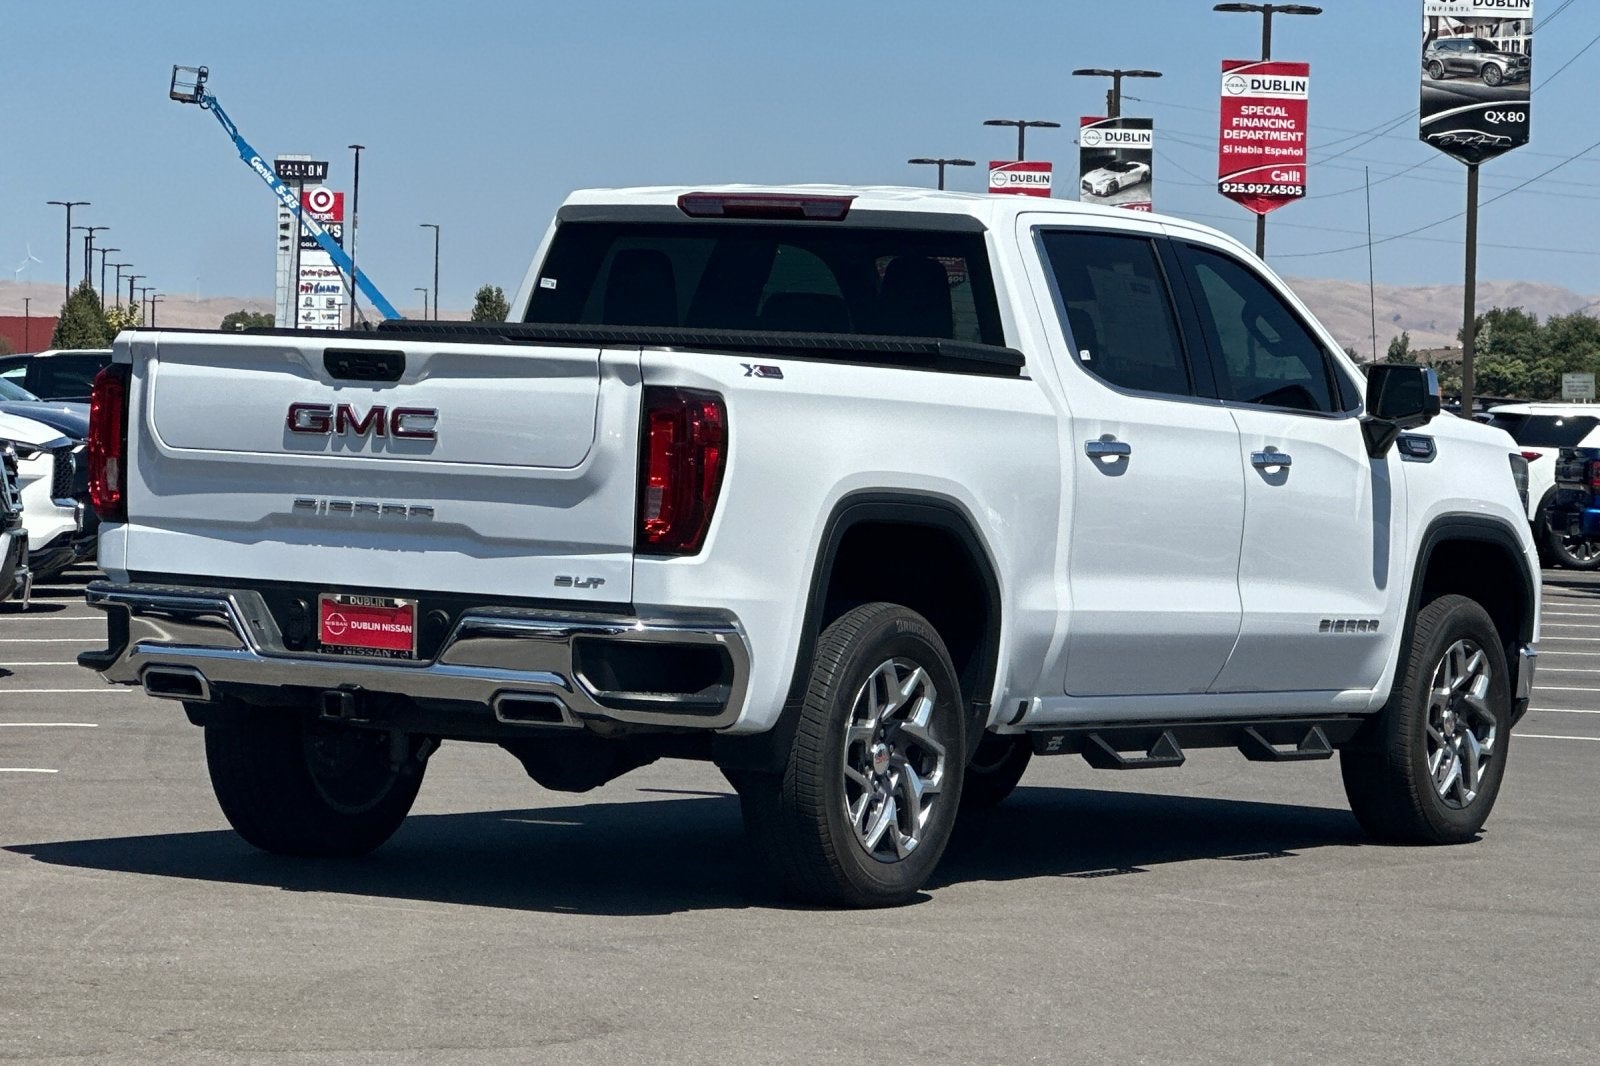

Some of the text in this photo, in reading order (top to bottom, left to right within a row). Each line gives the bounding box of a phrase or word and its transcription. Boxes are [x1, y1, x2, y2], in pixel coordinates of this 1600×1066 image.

[1473, 0, 1530, 8] DUBLIN
[1251, 79, 1306, 92] DUBLIN
[1240, 105, 1288, 117] SPECIAL
[1484, 110, 1526, 124] QX80
[1232, 117, 1296, 129] FINANCING
[1104, 131, 1151, 143] DUBLIN
[1223, 130, 1304, 142] DEPARTMENT
[1234, 145, 1263, 154] Habla
[1264, 146, 1304, 157] Español
[1010, 173, 1050, 184] DUBLIN
[1271, 170, 1300, 182] Call!
[250, 156, 300, 210] Genie S-85
[1222, 183, 1303, 195] 925.997.4505
[301, 223, 342, 238] DK'S
[286, 401, 439, 441] GMC
[554, 575, 606, 589] SLT
[349, 596, 385, 607] DUBLIN
[350, 621, 381, 631] DUBLIN
[381, 624, 412, 634] NISSAN
[1319, 618, 1380, 633] SIERRA
[343, 646, 391, 658] NISSAN
